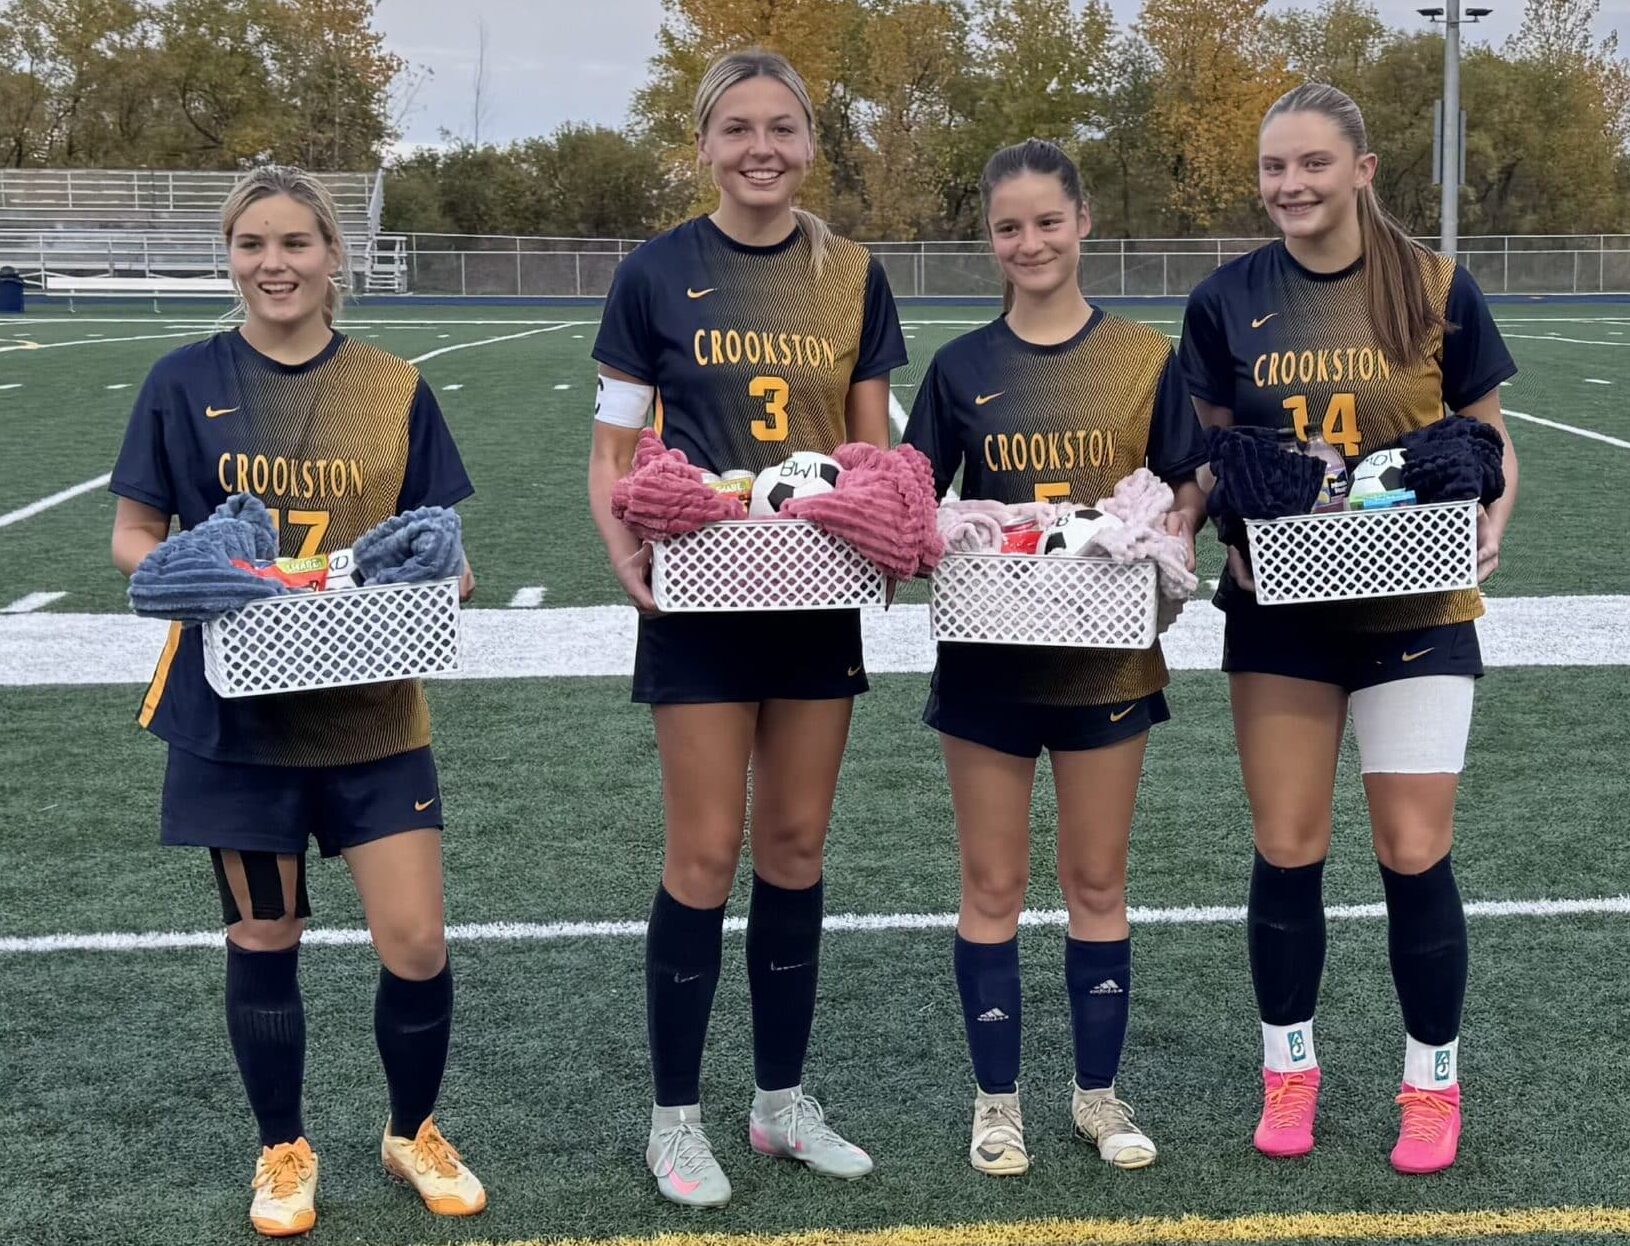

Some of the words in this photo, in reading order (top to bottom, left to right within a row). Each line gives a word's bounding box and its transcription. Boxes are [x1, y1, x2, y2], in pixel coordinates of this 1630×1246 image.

[694, 328, 834, 370] CROOKSTON
[1253, 347, 1390, 388] CROOKSTON
[749, 376, 789, 442] 3
[1282, 392, 1362, 456] 14
[984, 430, 1116, 472] CROOKSTON
[218, 452, 364, 498] CROOKSTON
